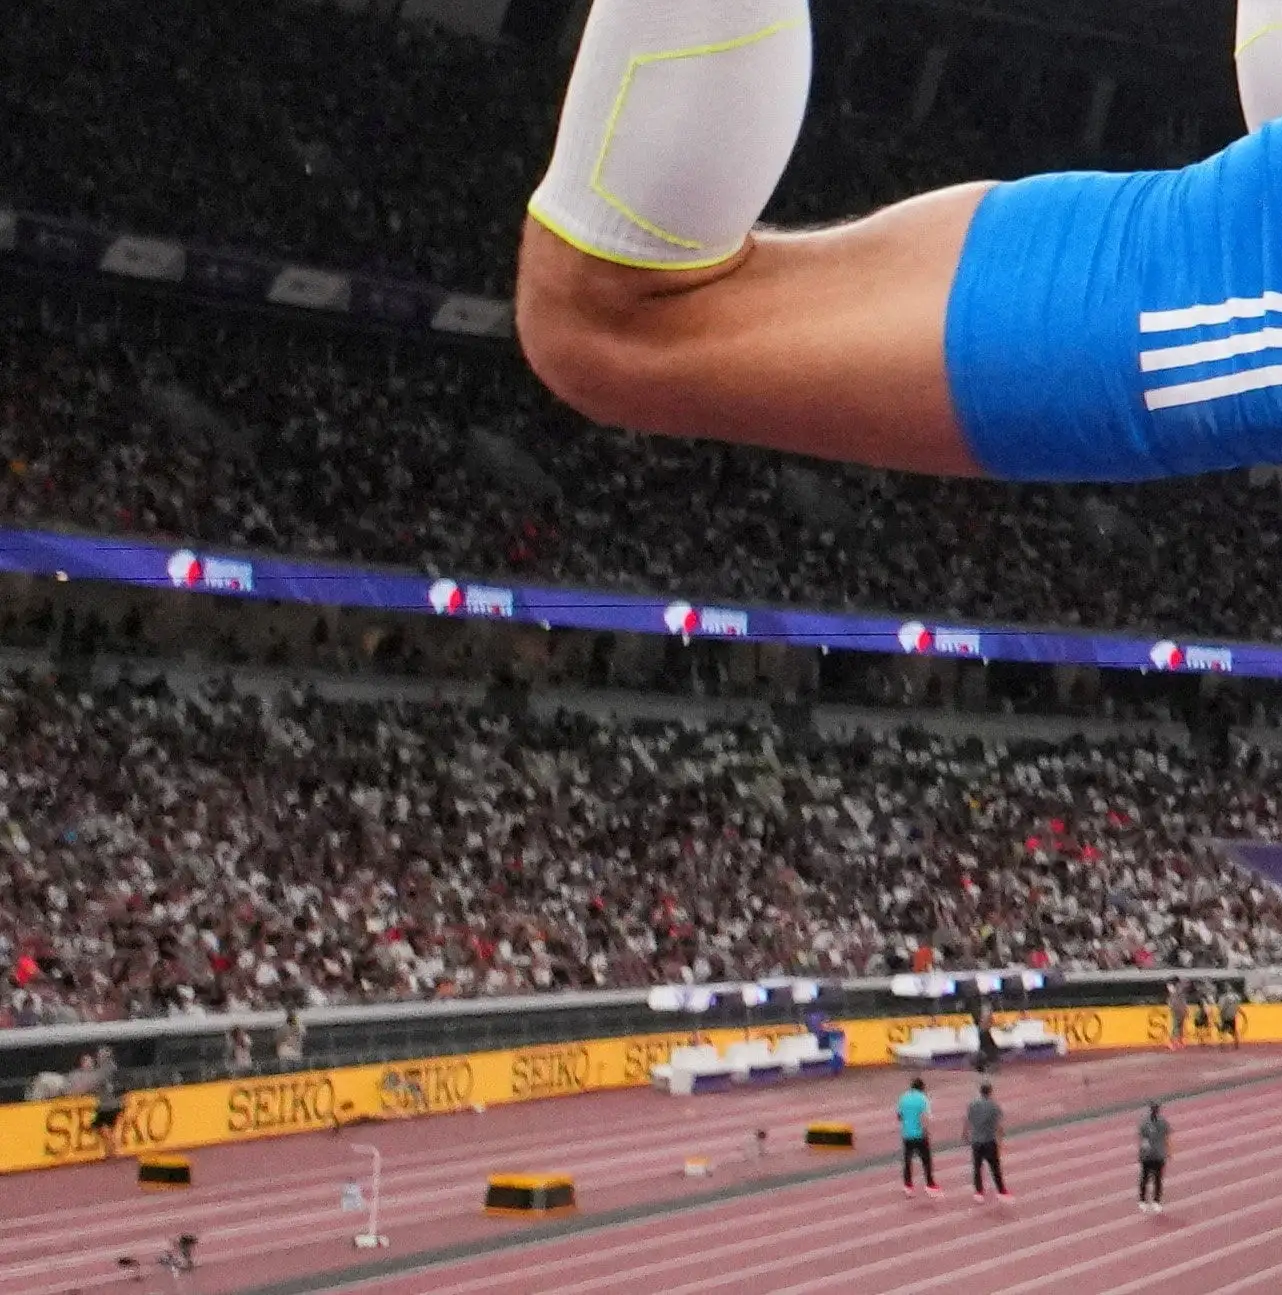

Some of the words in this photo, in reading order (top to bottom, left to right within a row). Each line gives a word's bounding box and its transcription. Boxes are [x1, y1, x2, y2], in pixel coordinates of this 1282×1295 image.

[44, 1094, 173, 1154] SEKO
[228, 1078, 335, 1132] SEIKO
[511, 1046, 591, 1097] SEIKO
